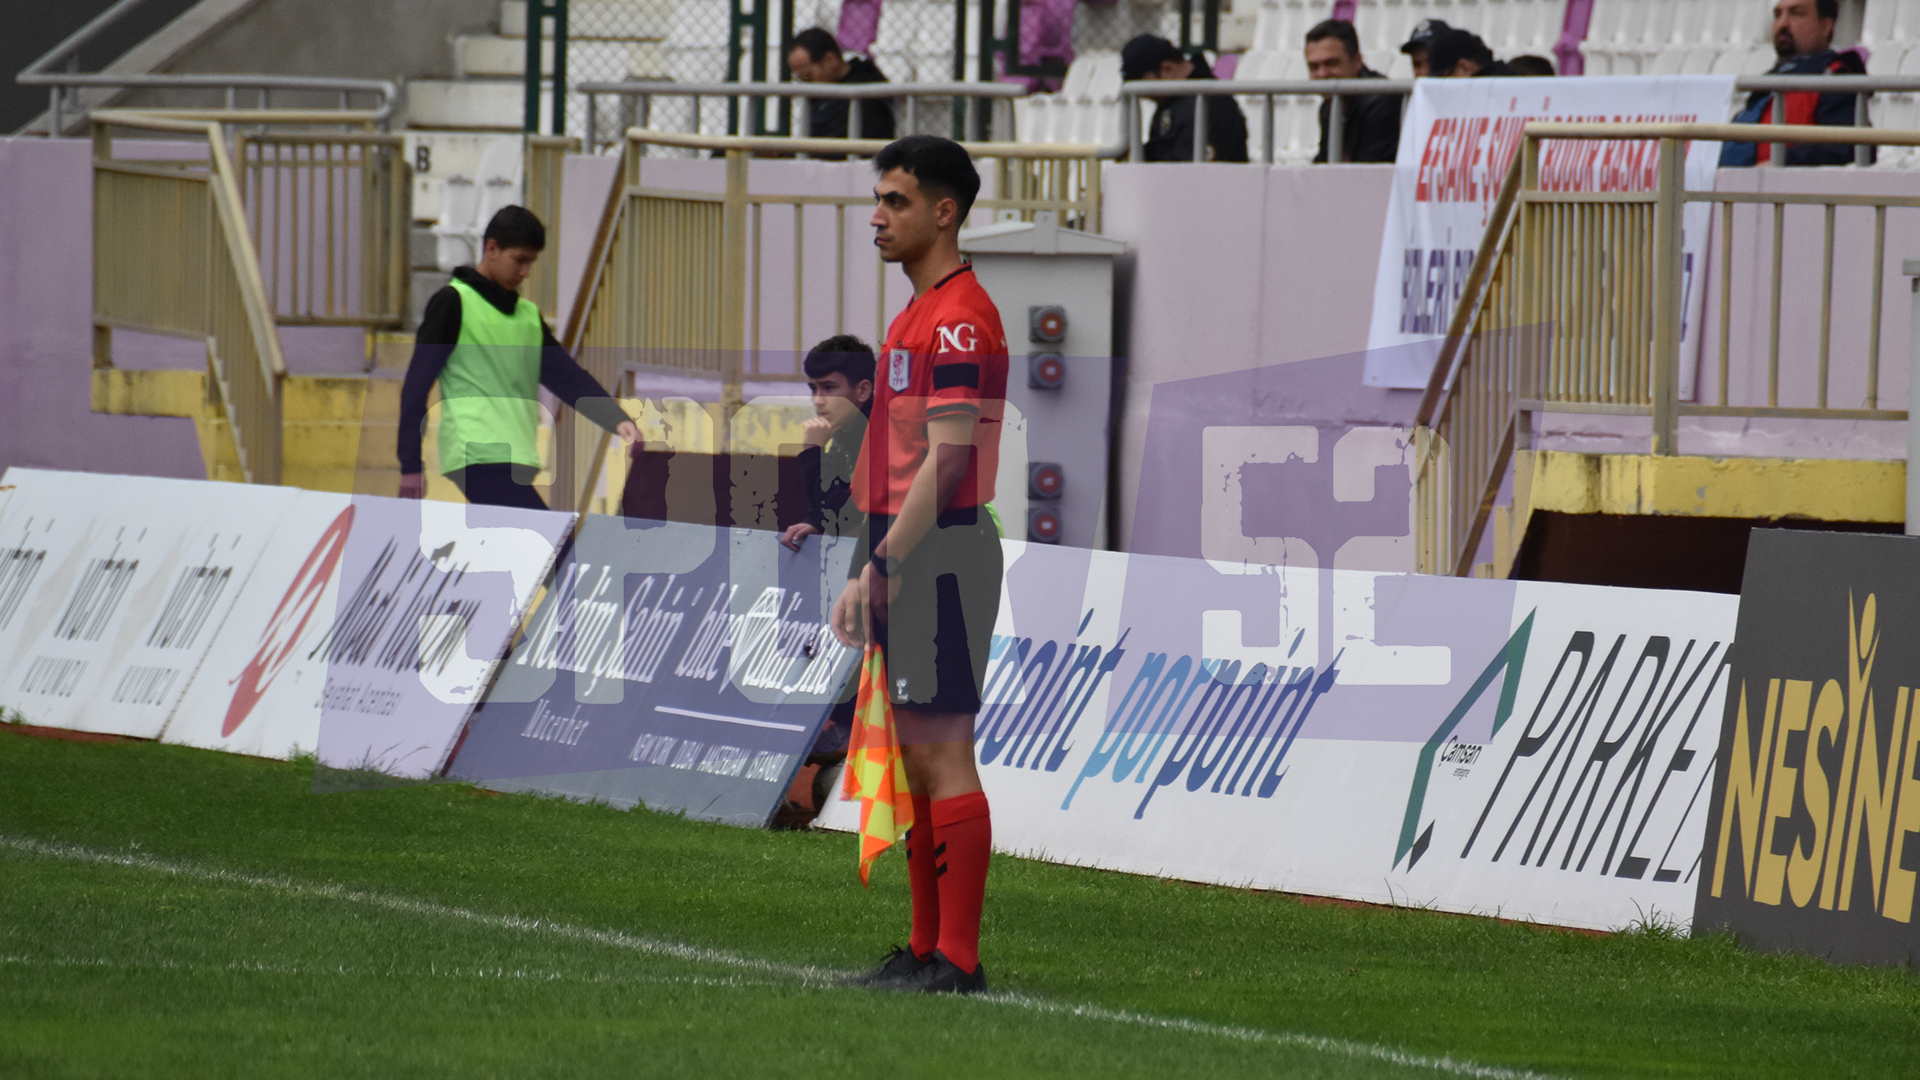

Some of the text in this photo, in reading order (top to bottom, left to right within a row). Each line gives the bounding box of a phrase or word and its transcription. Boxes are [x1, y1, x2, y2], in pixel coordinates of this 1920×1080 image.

[415, 146, 431, 172] B
[1416, 117, 1490, 203] EFSANE
[936, 322, 979, 354] NG
[516, 562, 618, 674] Nedim
[674, 582, 745, 682] blue
[1060, 628, 1346, 820] porpoint
[1438, 734, 1482, 767] Çamsan
